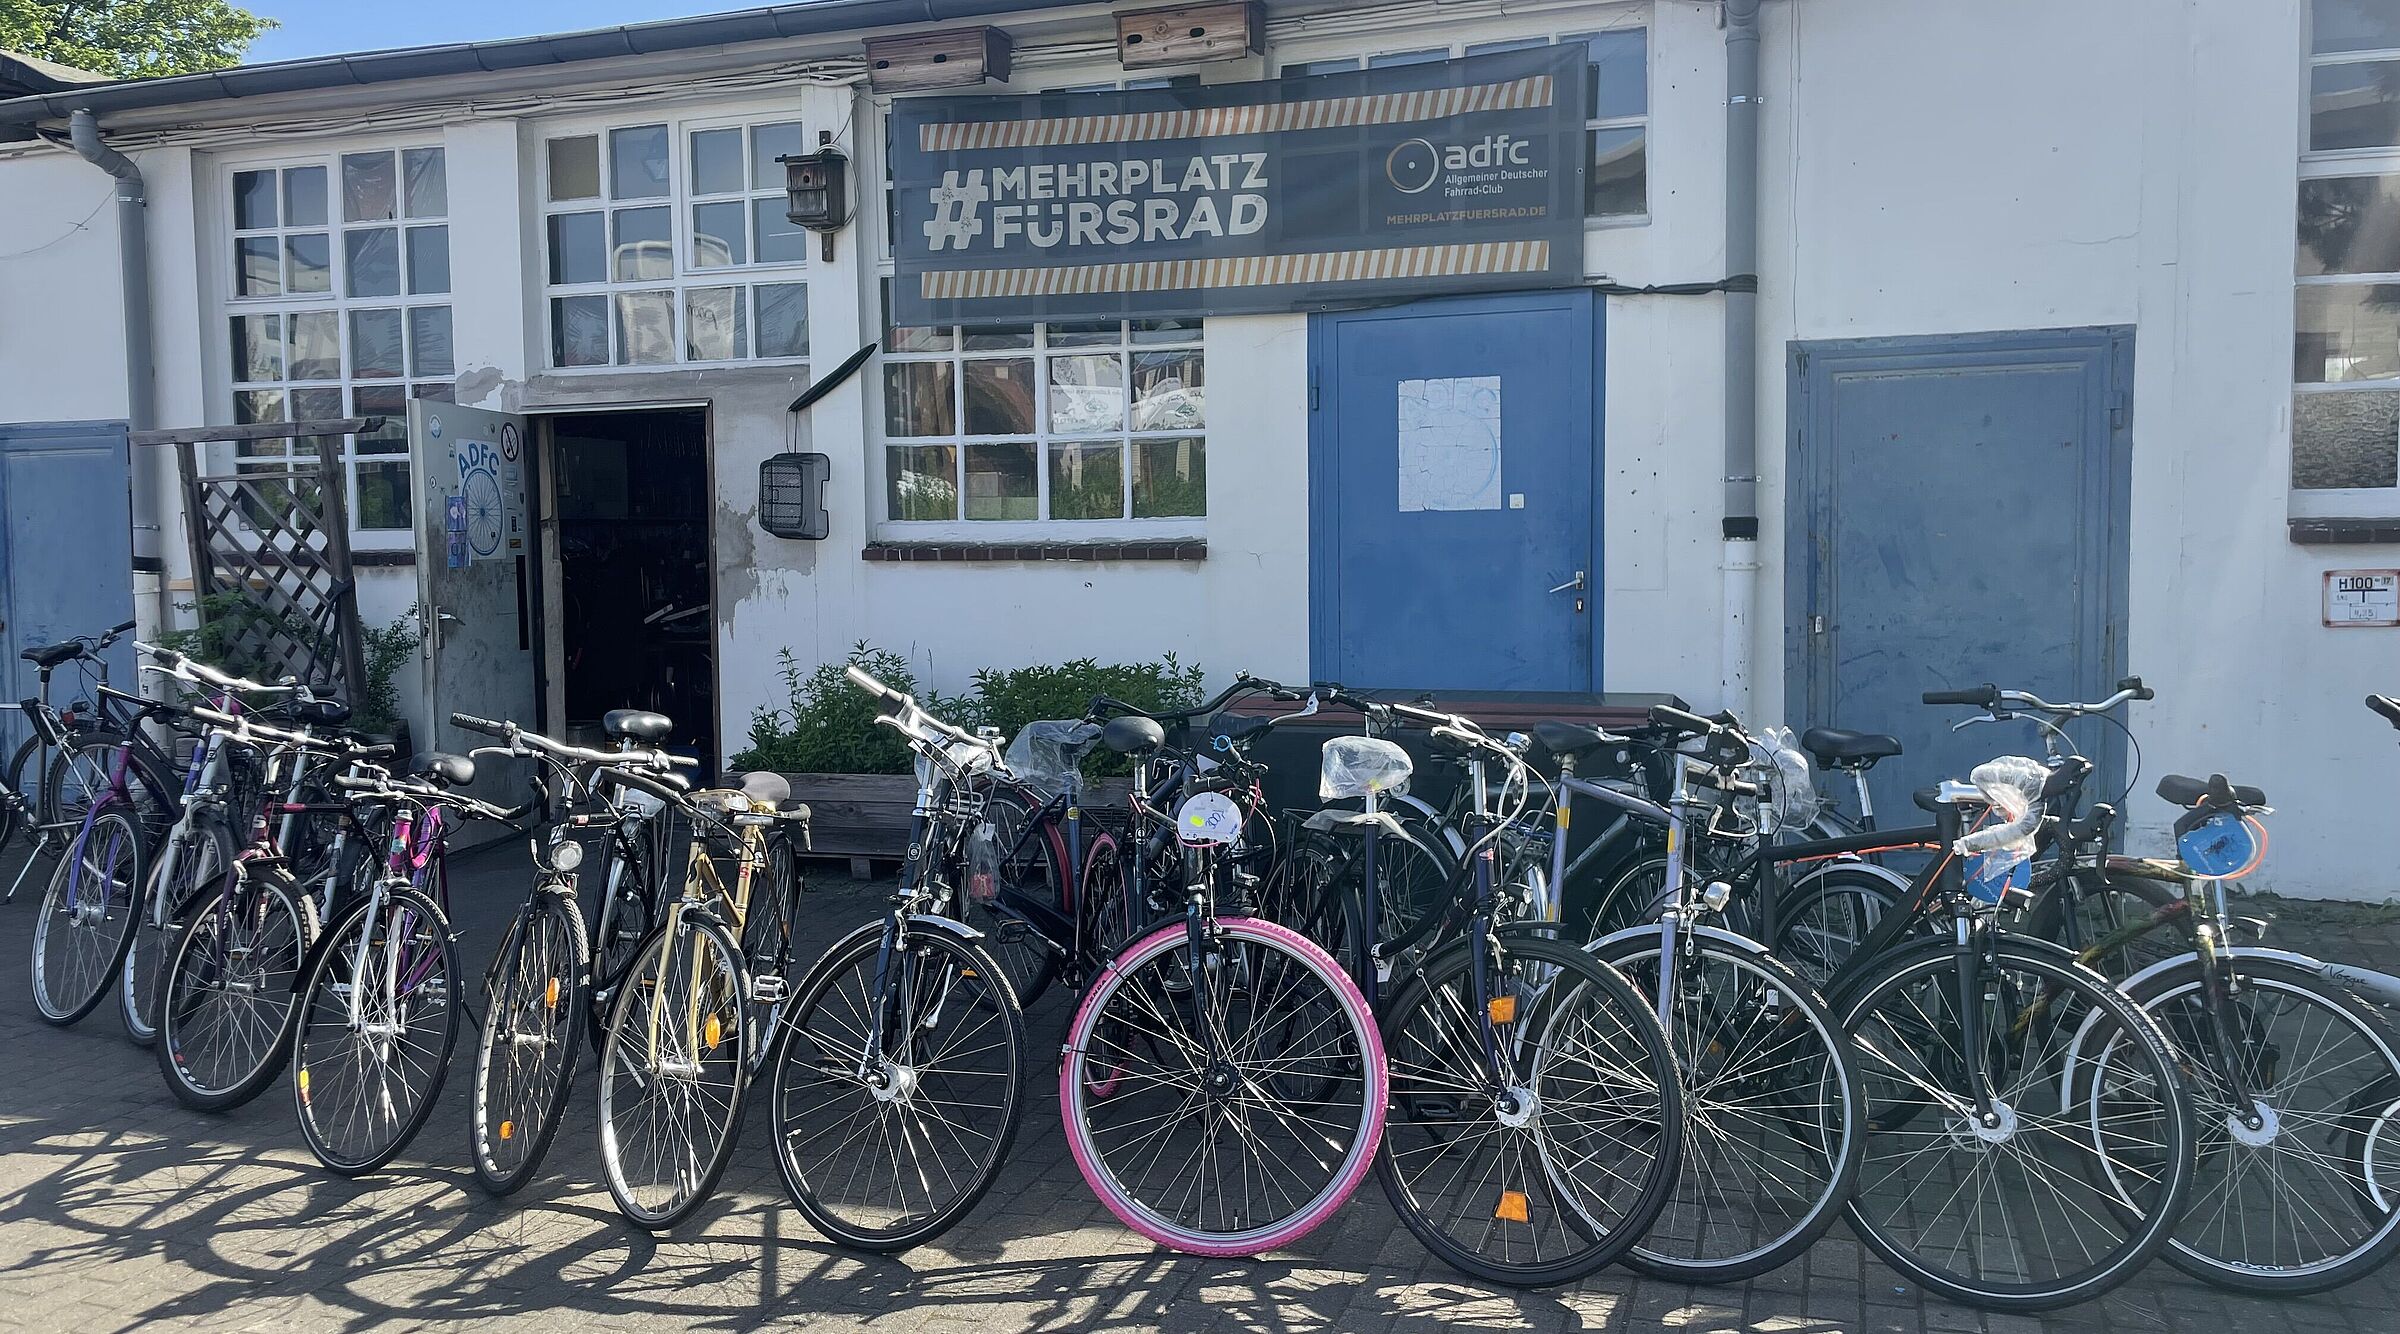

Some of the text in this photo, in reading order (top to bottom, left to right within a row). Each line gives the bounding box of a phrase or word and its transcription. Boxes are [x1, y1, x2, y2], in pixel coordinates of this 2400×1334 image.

[1444, 134, 1529, 170] adfc
[1445, 169, 1549, 186] Allgemeiner Deutscher
[1445, 184, 1504, 198] Fahrrad-Club
[993, 193, 1268, 249] FÜRSRAD
[1386, 205, 1547, 225] MEHRPLATZFUERSRAD.DE
[458, 442, 500, 479] ADFC
